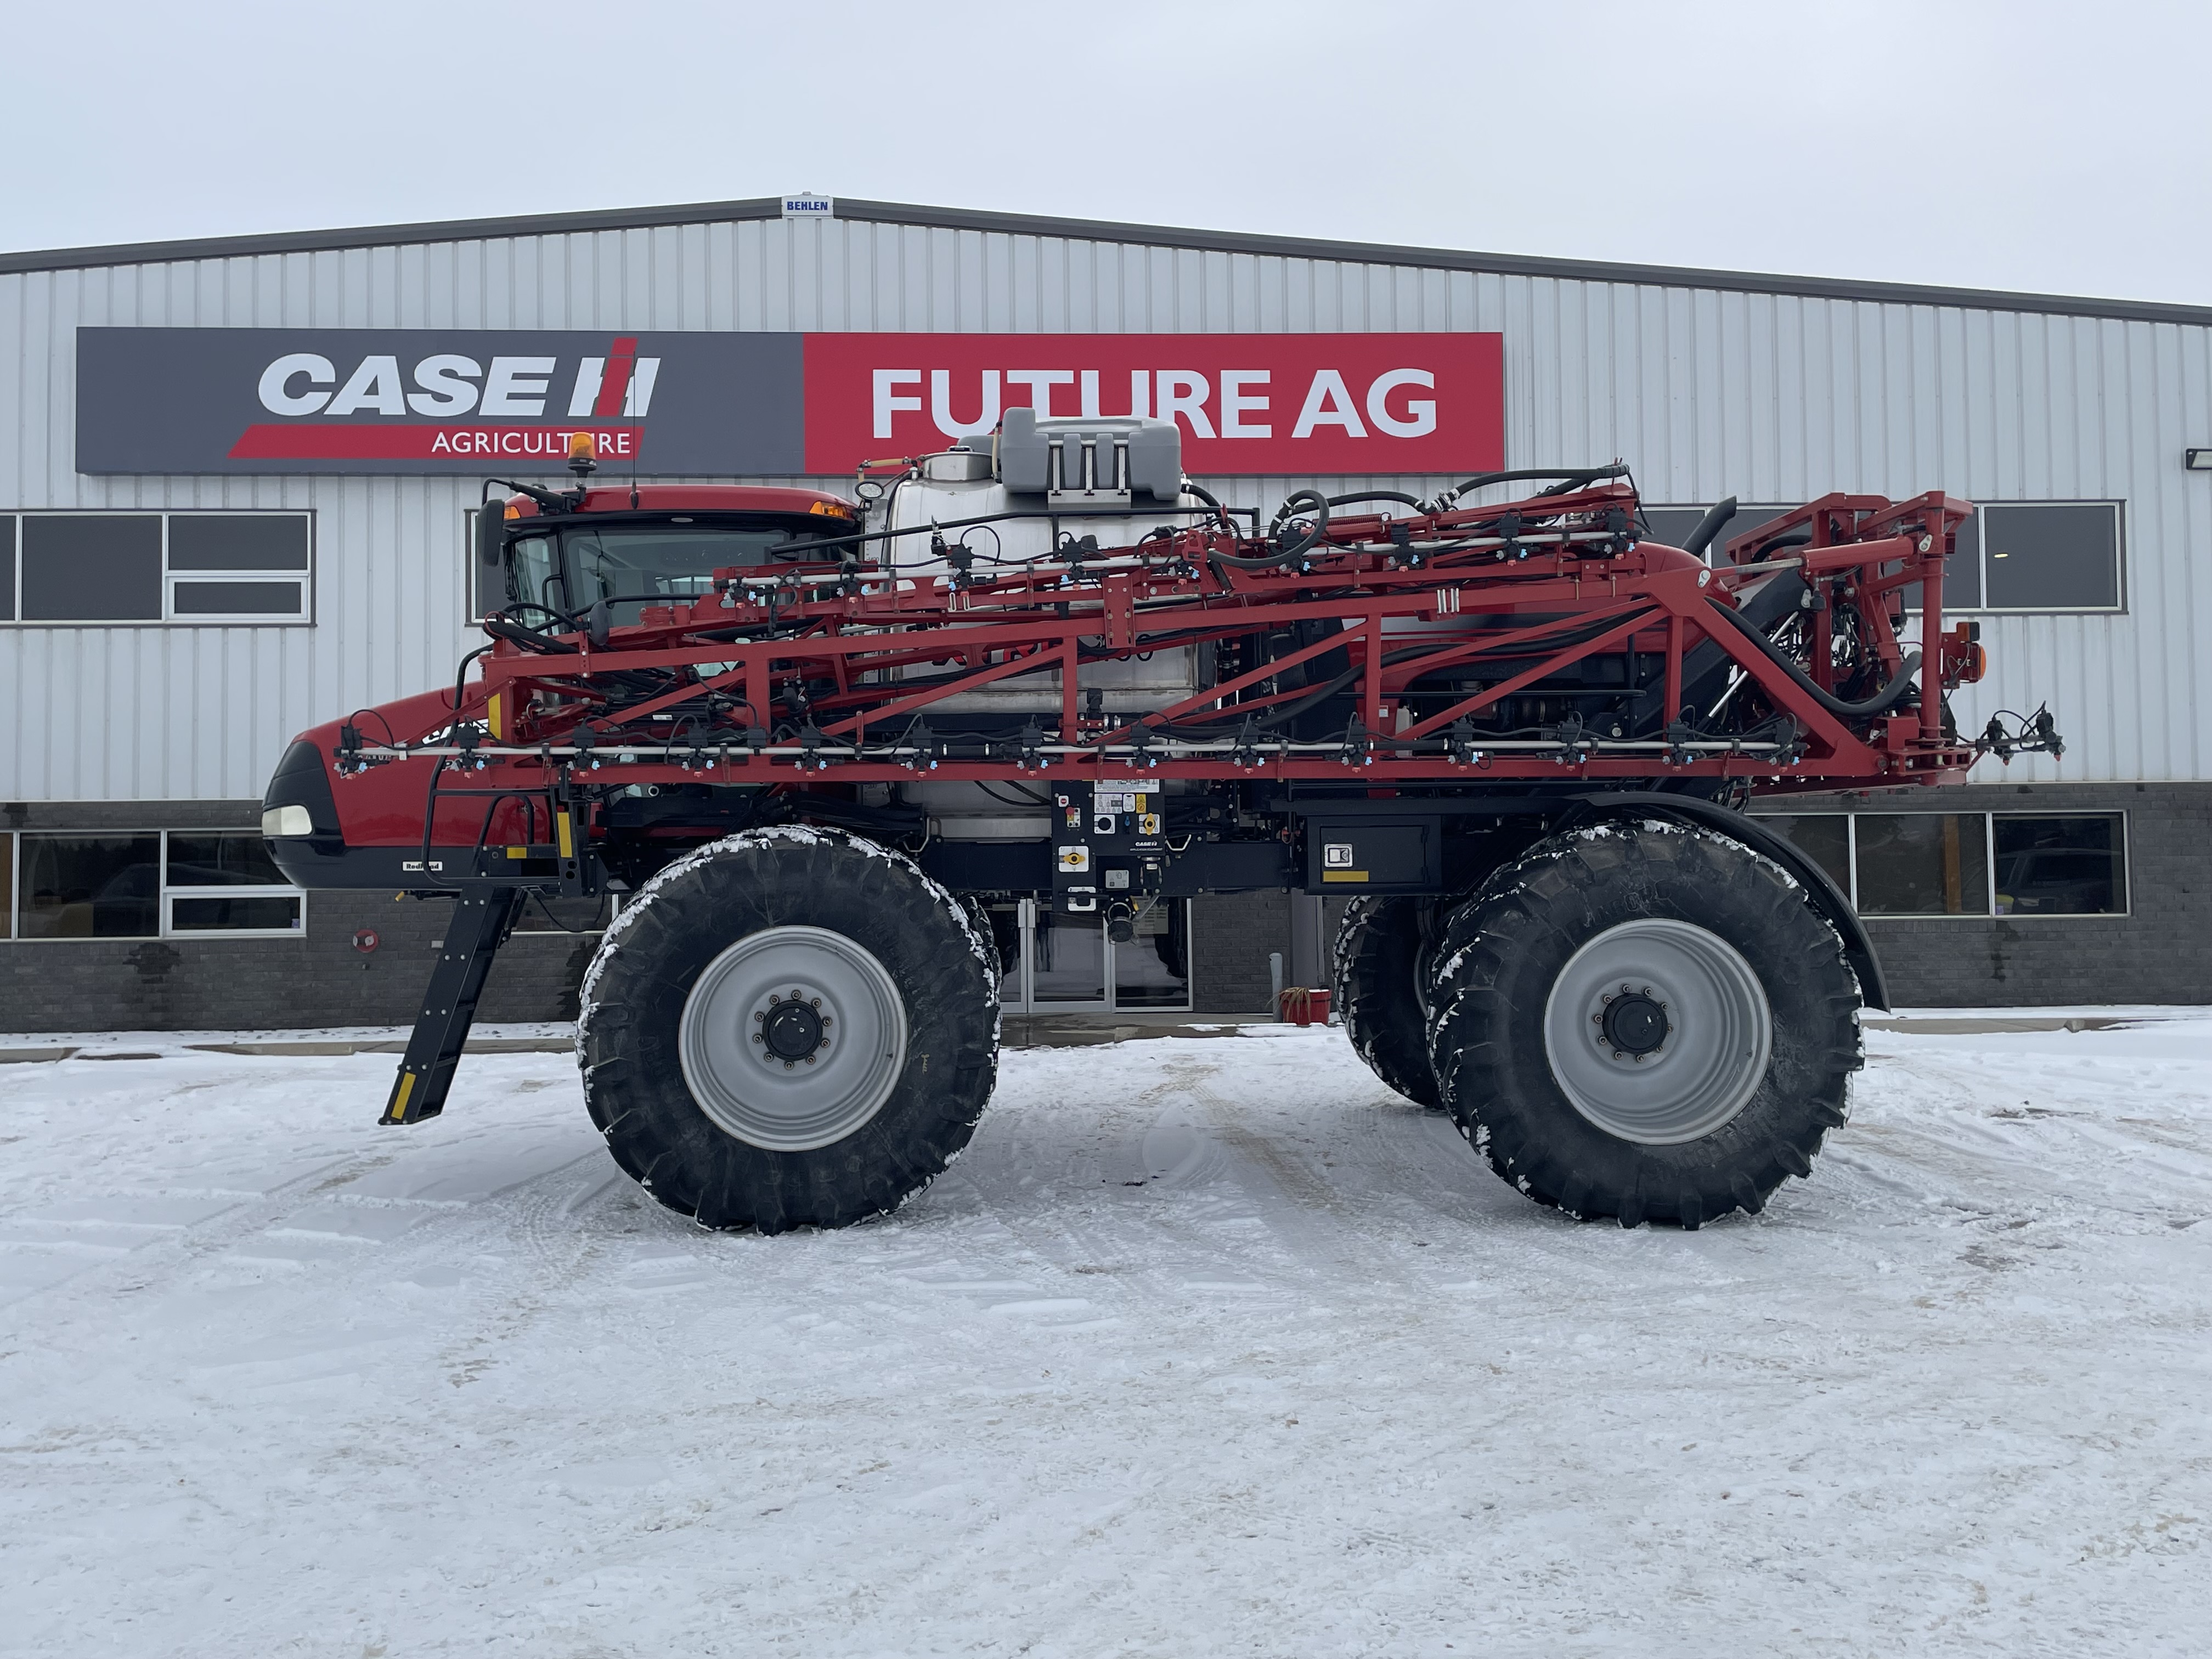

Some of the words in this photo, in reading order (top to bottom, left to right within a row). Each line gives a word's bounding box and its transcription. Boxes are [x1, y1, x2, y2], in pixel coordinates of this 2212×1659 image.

[787, 201, 828, 211] BEHLEN
[258, 353, 557, 417] CASE
[873, 369, 1272, 439] FUTURE
[1291, 368, 1437, 438] AG
[431, 432, 630, 454] AGRICULTRE
